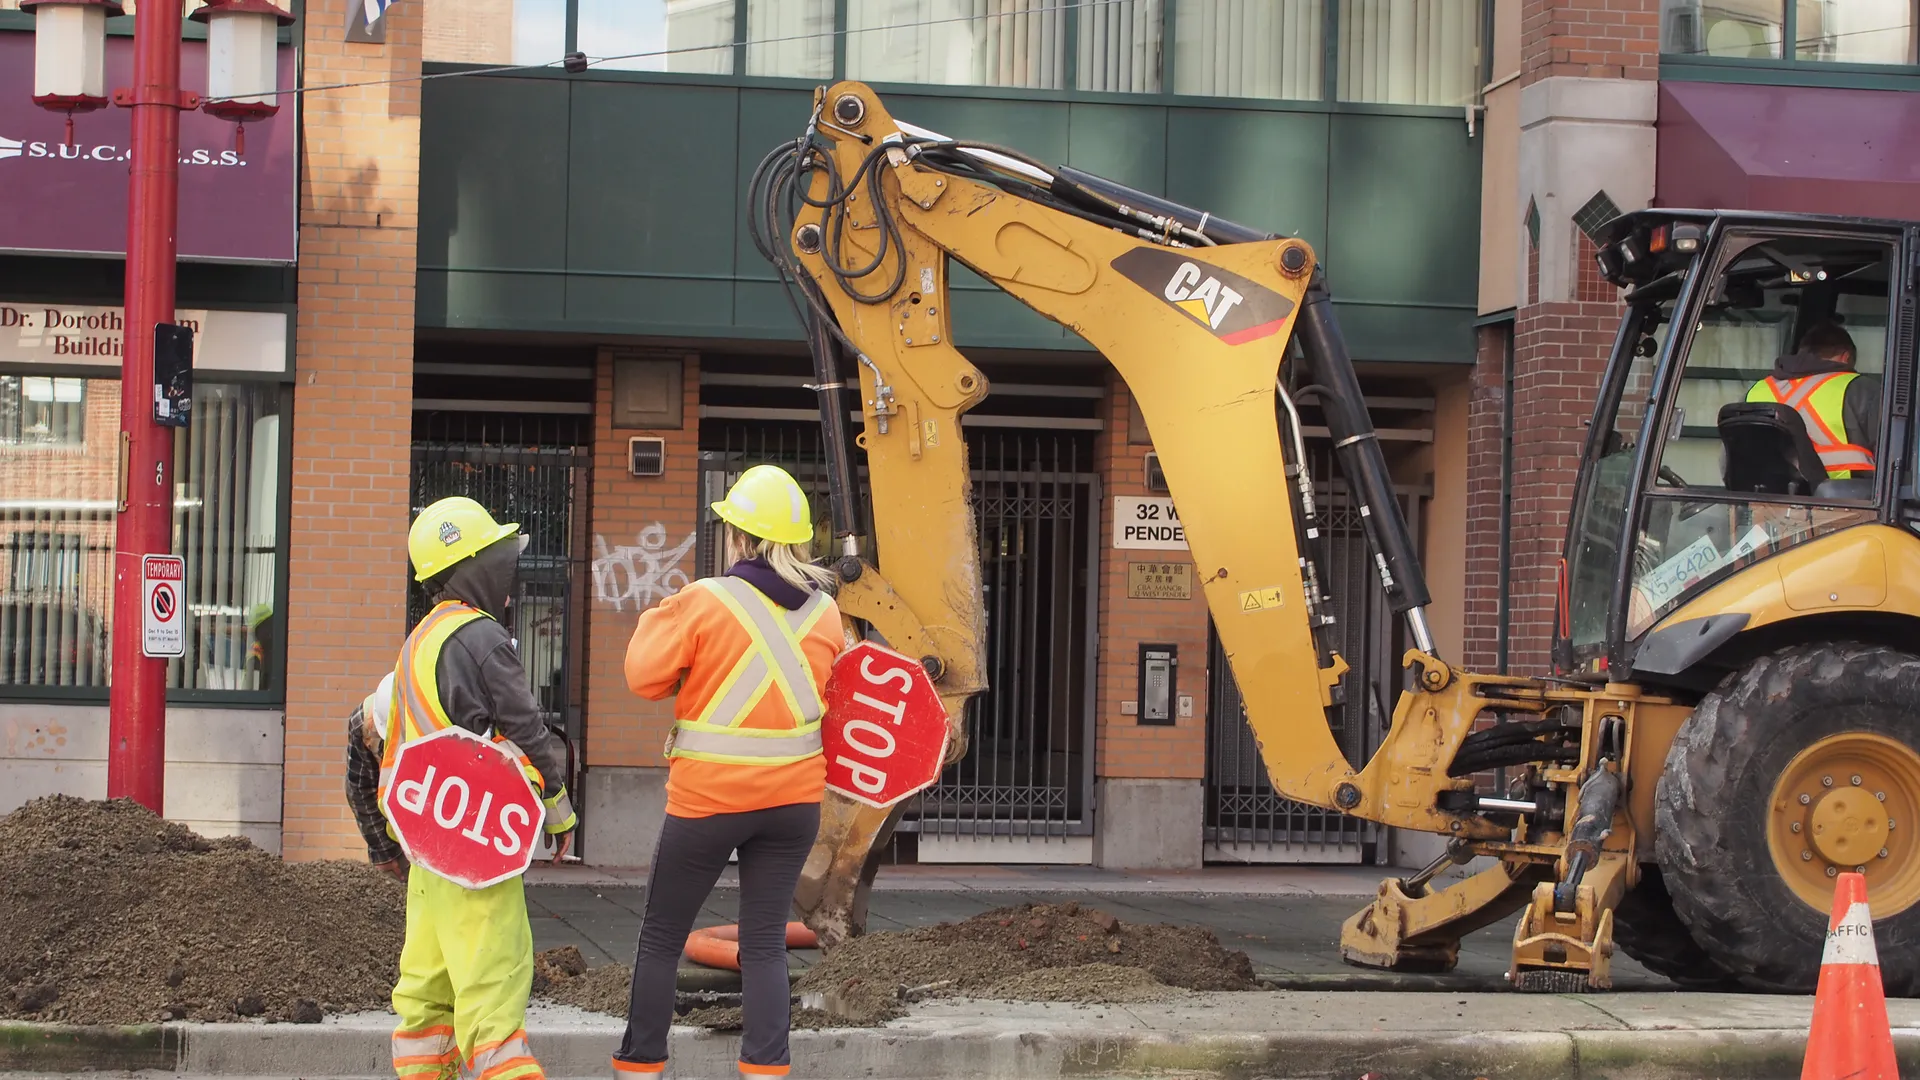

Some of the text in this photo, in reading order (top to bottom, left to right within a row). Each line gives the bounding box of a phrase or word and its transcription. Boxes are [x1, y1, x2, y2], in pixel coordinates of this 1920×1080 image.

[1165, 262, 1243, 330] CAT
[0, 307, 124, 330] Dr. Doroth
[54, 336, 124, 357] Buildi
[1136, 504, 1160, 520] 32
[1125, 526, 1187, 541] PENDE
[147, 562, 181, 579] TEMPORARY
[835, 655, 913, 794] STOP
[396, 765, 530, 856] STOP
